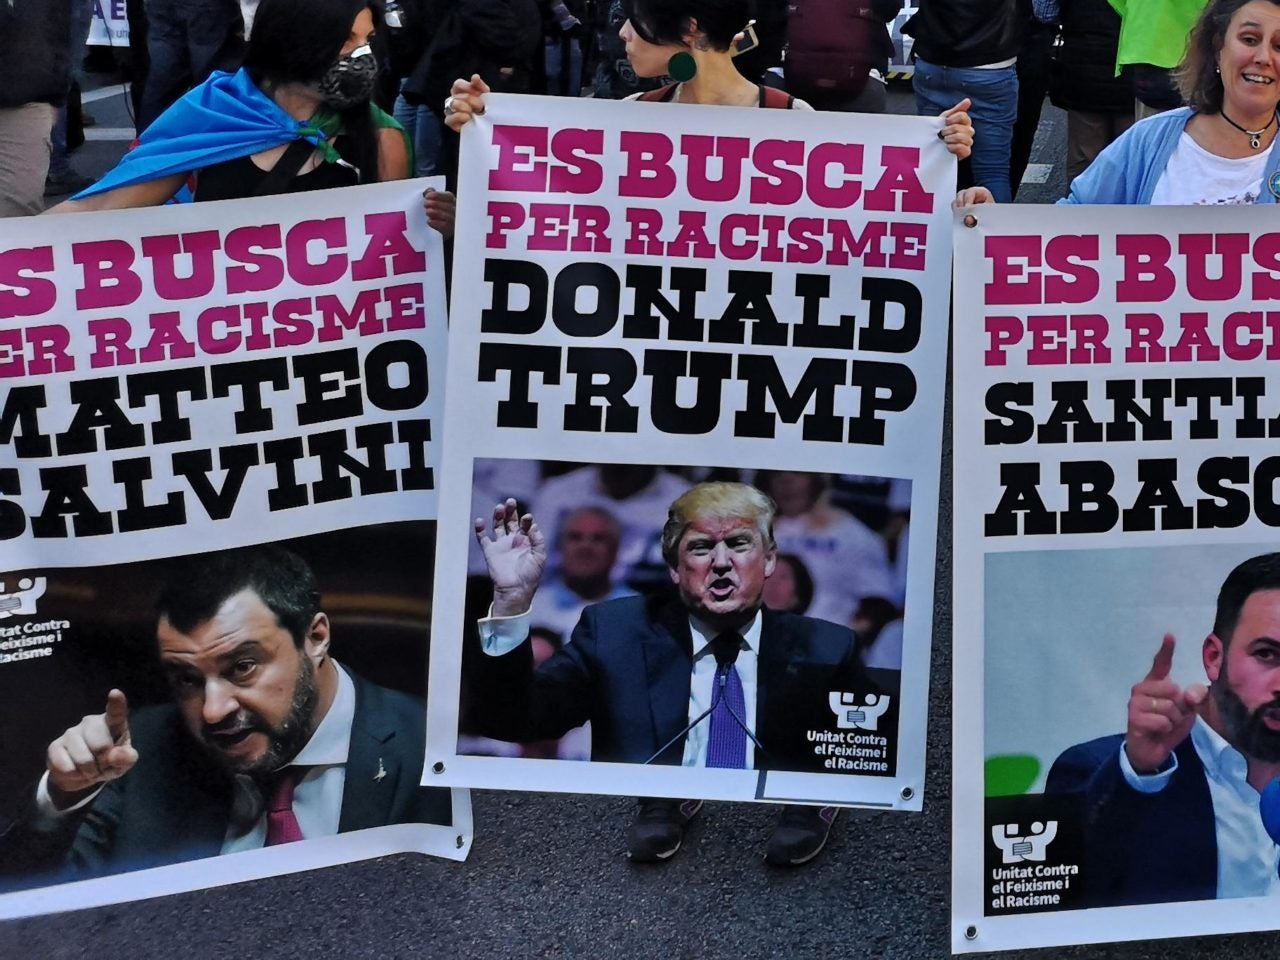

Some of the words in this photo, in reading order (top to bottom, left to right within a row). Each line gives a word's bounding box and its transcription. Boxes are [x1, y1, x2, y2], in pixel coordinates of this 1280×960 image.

[488, 123, 604, 195] ES
[617, 130, 934, 213] BUSCA
[485, 200, 612, 253] PER
[625, 207, 927, 271] RACISME
[0, 246, 57, 319] S
[72, 211, 426, 310] BUSCA
[984, 233, 1099, 306] ES
[480, 259, 923, 353] DONALD
[0, 324, 75, 378] ER
[88, 283, 425, 369] RACISME
[984, 313, 1111, 367] PER
[477, 342, 917, 446] TRUMP
[23, 620, 70, 634] Contra
[0, 635, 56, 650] eixisme
[57, 630, 62, 642] i
[0, 647, 53, 664] acisme
[806, 730, 845, 743] Unitat
[846, 733, 887, 746] Contra
[814, 744, 826, 754] el
[828, 744, 880, 758] Feixisme
[882, 746, 886, 758] i
[824, 757, 836, 768] el
[838, 758, 888, 771] Racisme
[992, 866, 1033, 880] Unitat
[1035, 864, 1078, 876] Contra
[992, 882, 1004, 894] el
[1006, 878, 1063, 893] Feixisme
[1065, 876, 1070, 888] i
[992, 896, 1004, 908] el
[1006, 892, 1060, 908] Racisme
